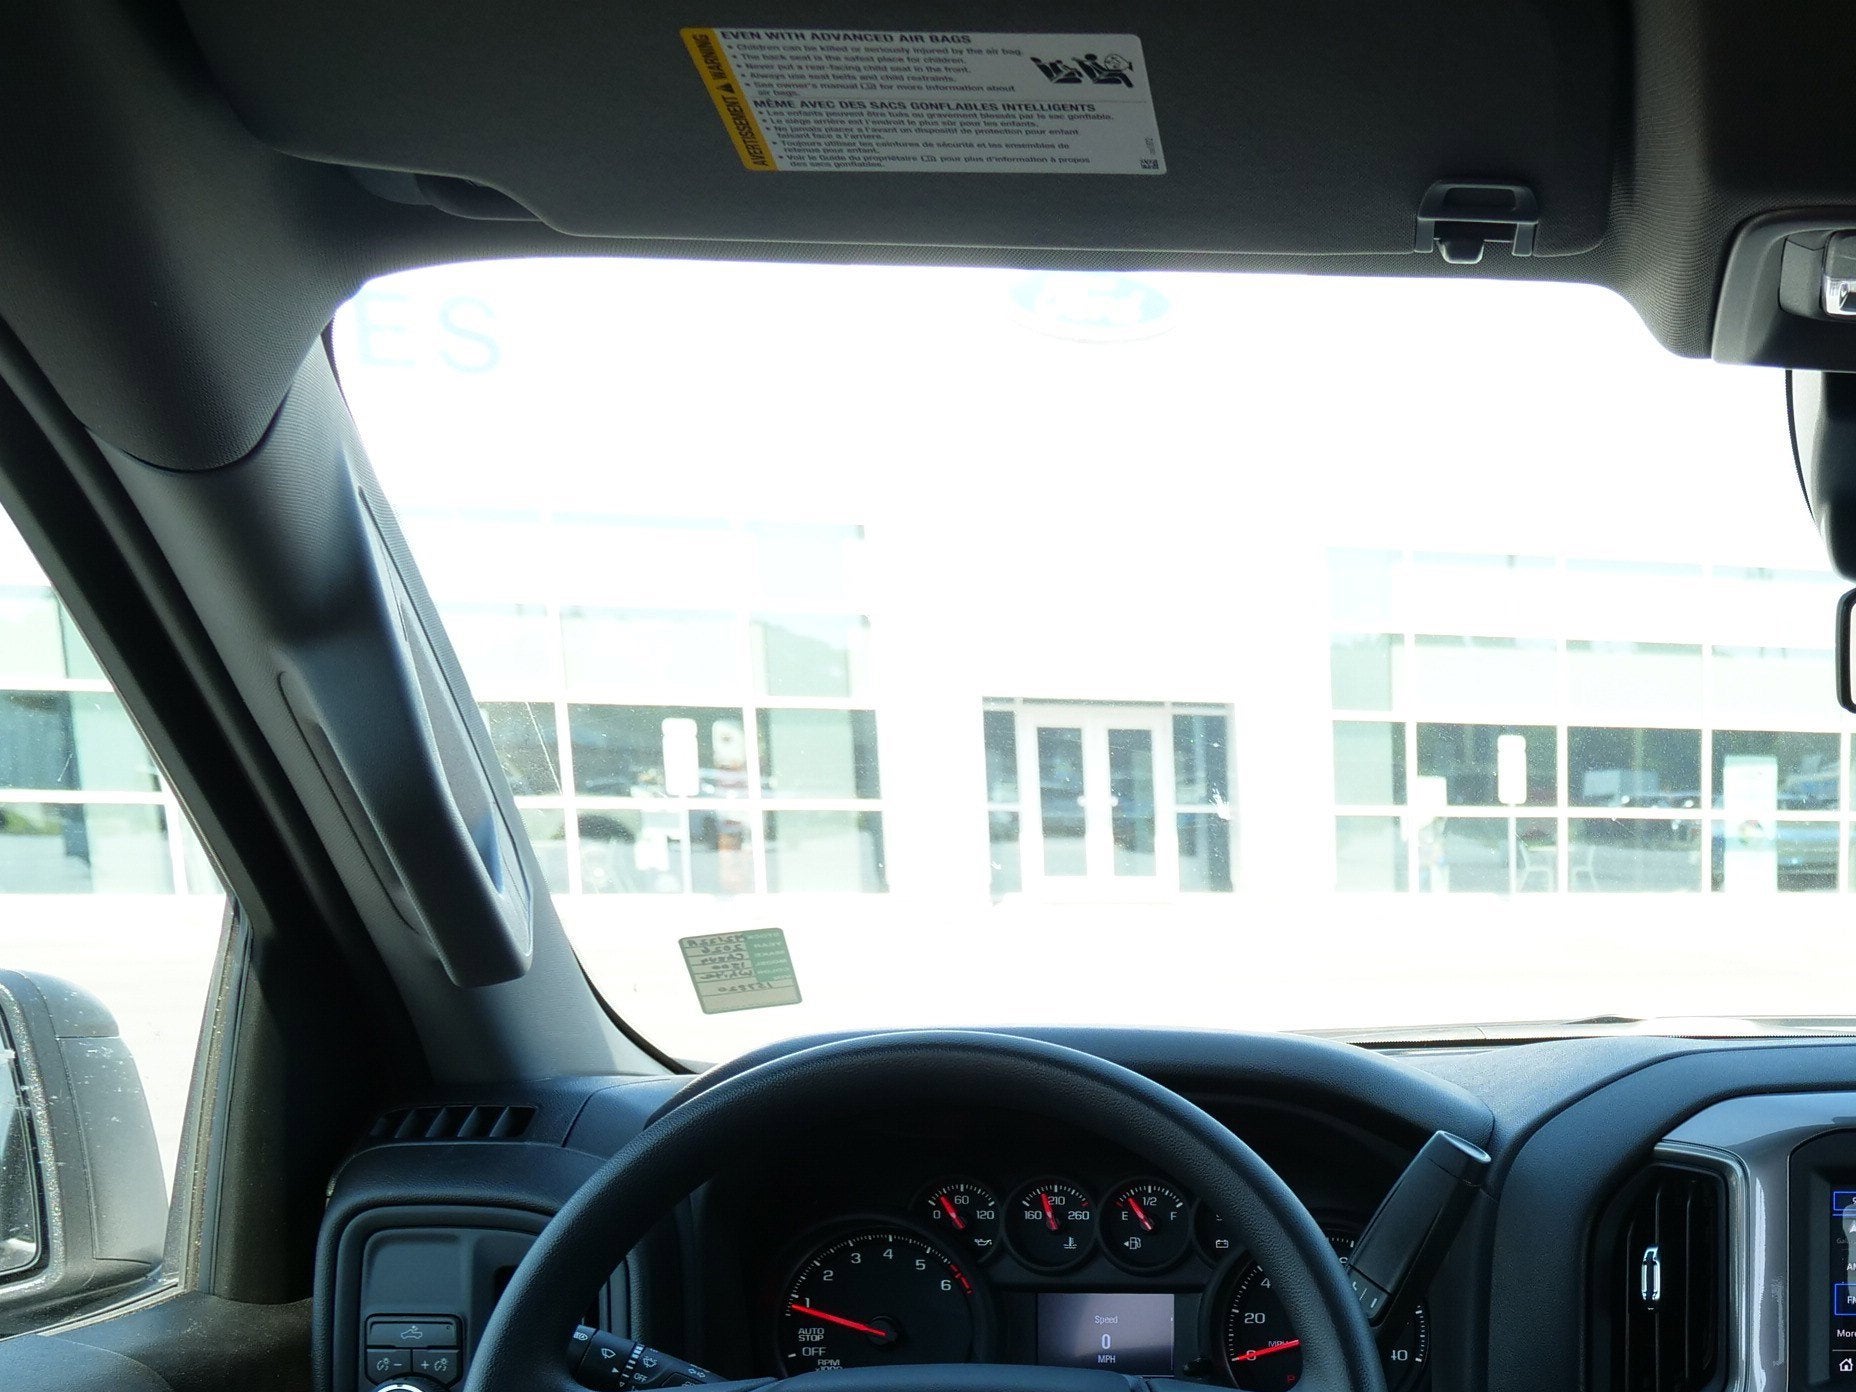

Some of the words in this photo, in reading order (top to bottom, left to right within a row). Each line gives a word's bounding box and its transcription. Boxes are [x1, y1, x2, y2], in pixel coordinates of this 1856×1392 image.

[720, 31, 760, 40] EVEN
[764, 32, 806, 41] WITH
[811, 33, 894, 42] ADVANCED
[899, 34, 926, 43] AIR
[929, 34, 972, 44] BAGS
[799, 101, 836, 109] AVEC
[840, 101, 867, 110] DES
[870, 101, 907, 110] SACS
[910, 102, 999, 111] GONFLABLES
[1003, 103, 1096, 112] INTELLIGENTS
[954, 1195, 970, 1205] 60
[1048, 1196, 1066, 1206] 210
[1143, 1196, 1158, 1206] 1/2
[933, 1211, 941, 1220] 0
[976, 1211, 995, 1220] 120
[1025, 1211, 1043, 1220] 160
[1068, 1211, 1090, 1220] 260
[1122, 1212, 1129, 1221] E
[1171, 1212, 1177, 1221] F
[850, 1253, 862, 1264] 3
[883, 1248, 894, 1260] 4
[915, 1260, 926, 1271] 5
[823, 1270, 835, 1281] 2
[941, 1280, 952, 1291] 6
[805, 1297, 810, 1308] 1
[1094, 1315, 1118, 1325] Speed
[1244, 1312, 1266, 1324] 20
[798, 1327, 825, 1335] AUTO
[798, 1334, 824, 1342] STOP
[1101, 1333, 1111, 1350] 0
[802, 1346, 826, 1356] OFF
[1098, 1355, 1116, 1363] MPH
